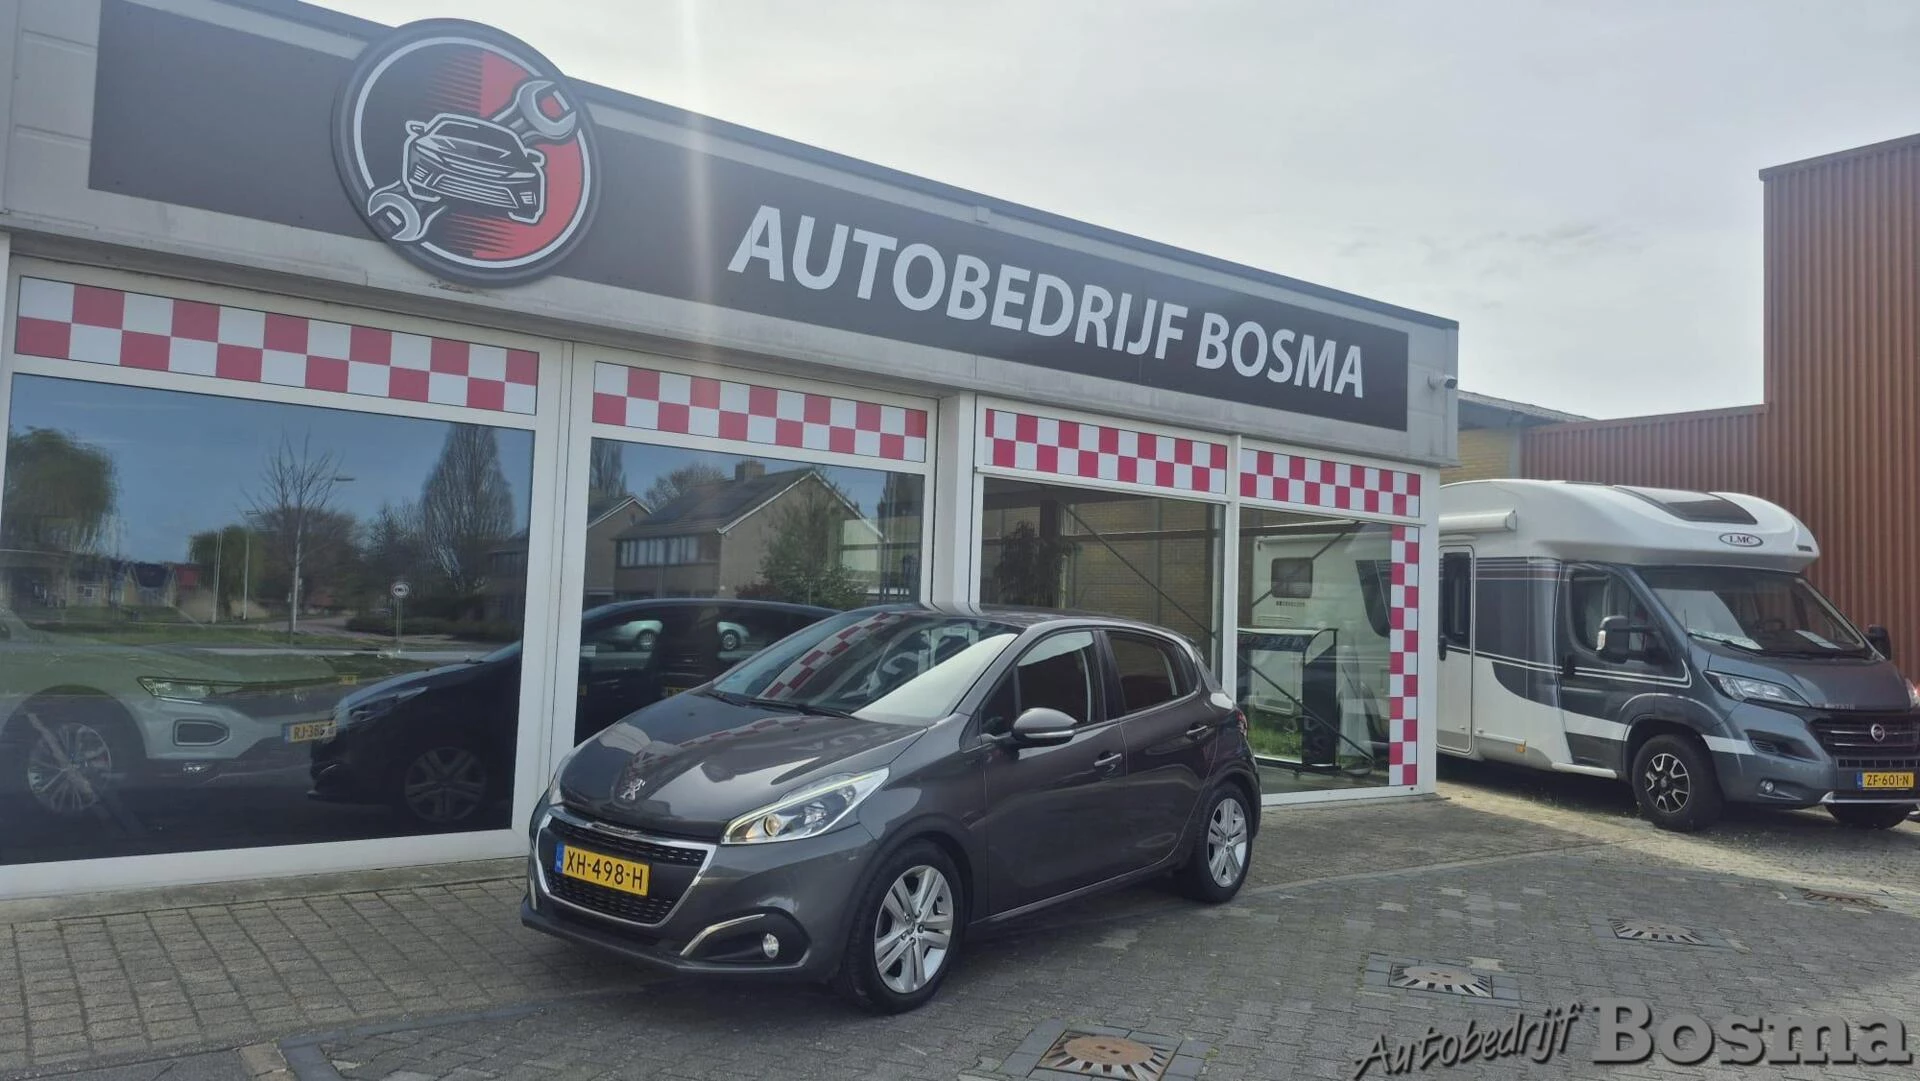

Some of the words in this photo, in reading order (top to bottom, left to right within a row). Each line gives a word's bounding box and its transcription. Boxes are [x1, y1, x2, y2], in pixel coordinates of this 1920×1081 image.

[727, 204, 1190, 360] AUTOBEDRIJF
[1196, 312, 1365, 399] BOSMA
[1729, 535, 1753, 544] LMC
[1866, 774, 1910, 787] ZF-601-N
[566, 851, 643, 891] XH-498-H
